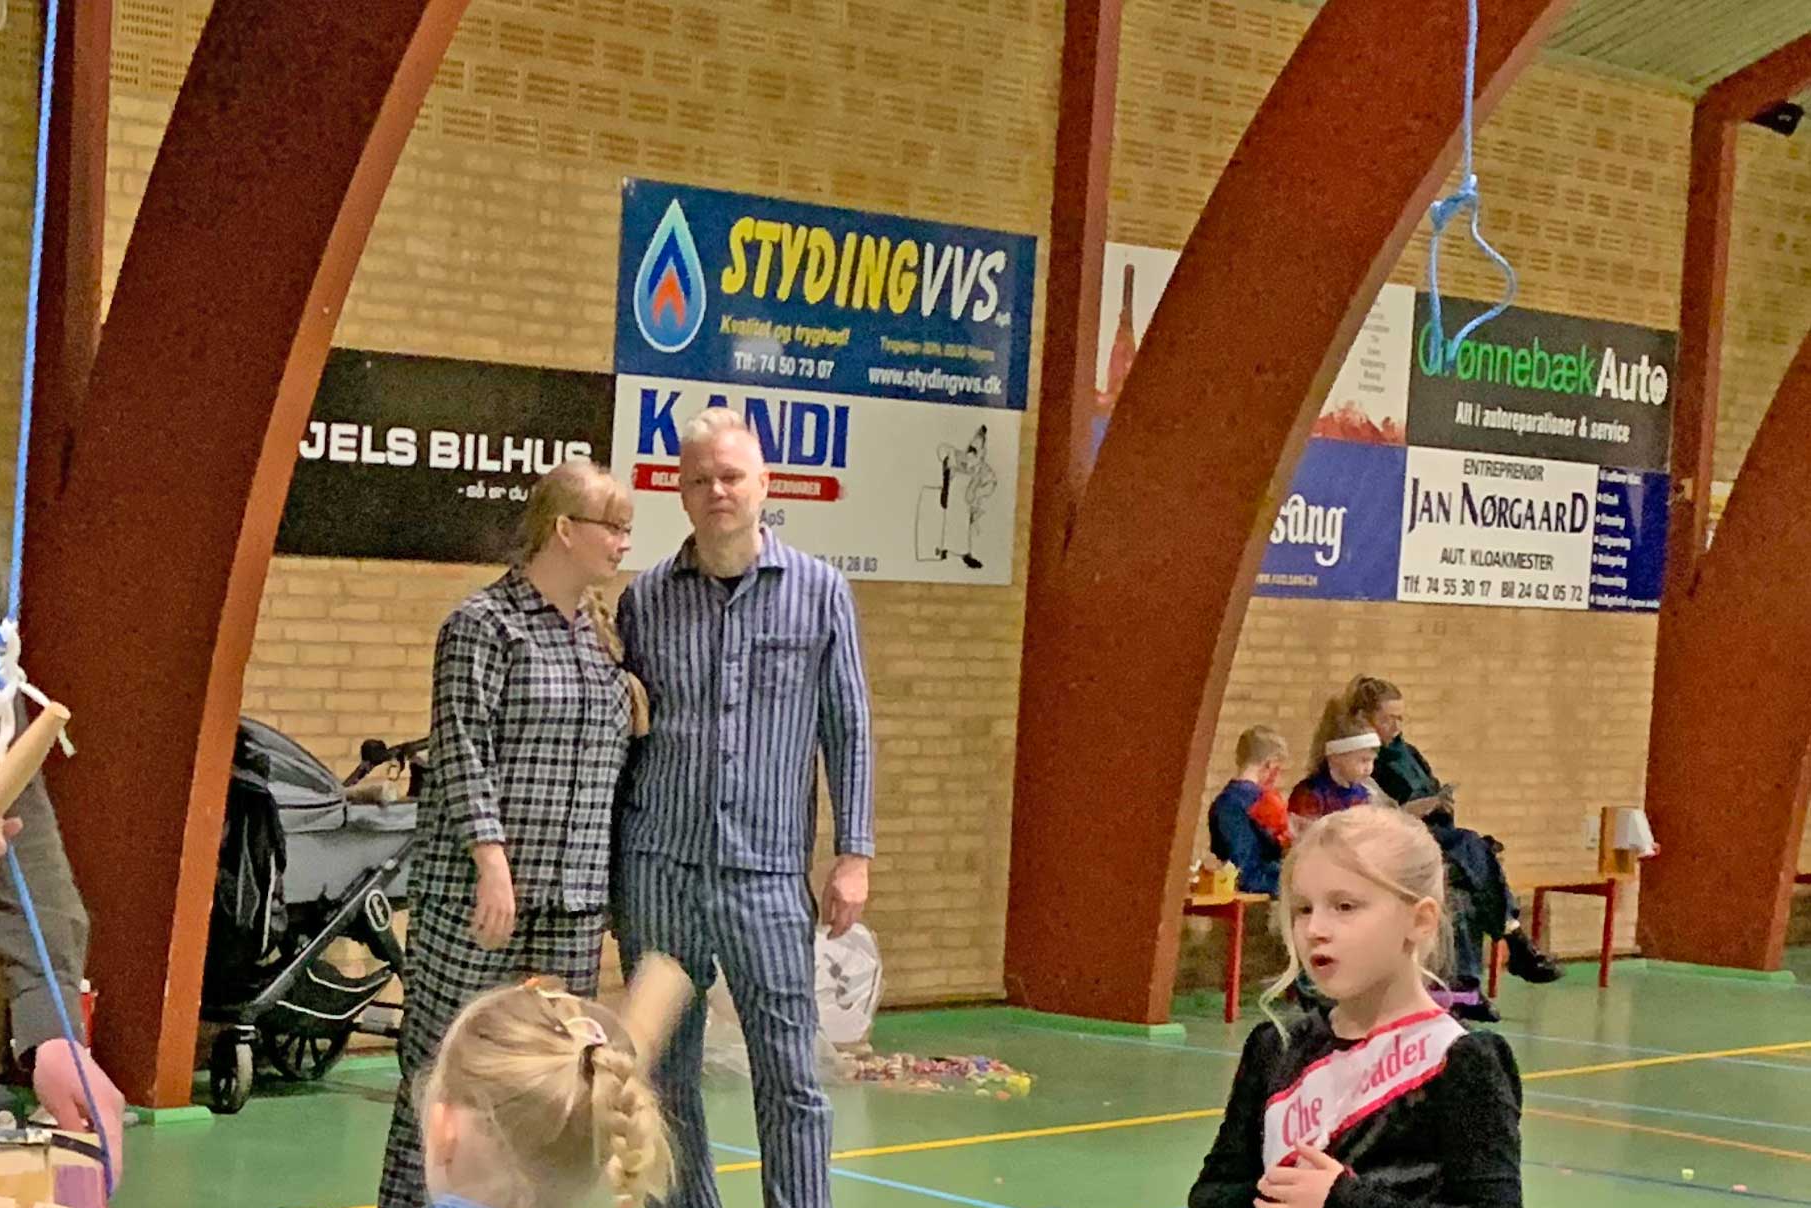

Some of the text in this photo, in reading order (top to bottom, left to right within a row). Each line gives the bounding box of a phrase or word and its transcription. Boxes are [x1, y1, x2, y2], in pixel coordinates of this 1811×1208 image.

[760, 354, 776, 373] 74
[779, 356, 796, 376] 50
[799, 358, 815, 378] 73
[817, 359, 835, 379] 07
[868, 367, 1002, 396] www.stydingvvs.dk
[637, 388, 850, 468] KNDI
[1482, 406, 1576, 436] autoreparationer
[1590, 418, 1631, 443] service
[299, 421, 418, 467] JELS
[1463, 458, 1544, 482] ENTREPRENØR
[1408, 477, 1589, 534] JAN NØRGAARD
[1470, 549, 1555, 571] KLOAKMESTER
[1443, 578, 1457, 597] 55
[1460, 578, 1476, 597] 30
[1518, 582, 1533, 600] 24
[1571, 585, 1583, 602] 72
